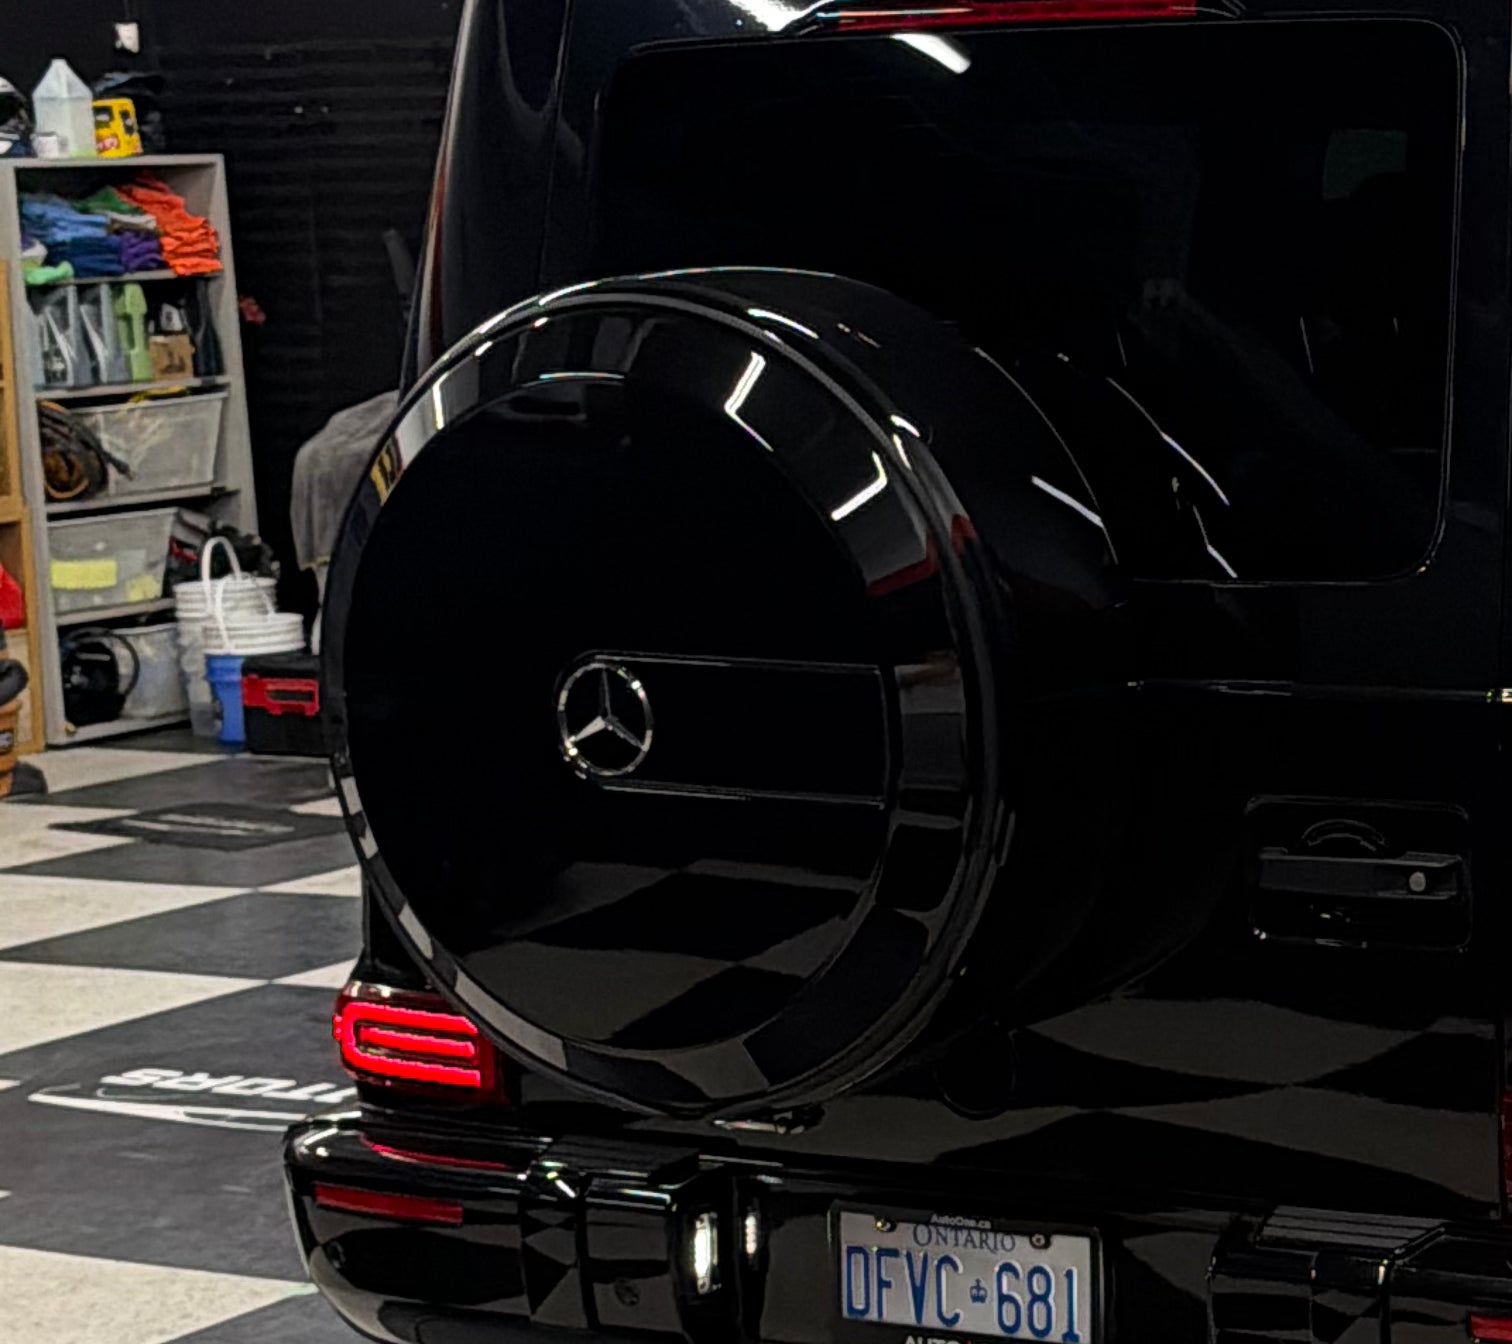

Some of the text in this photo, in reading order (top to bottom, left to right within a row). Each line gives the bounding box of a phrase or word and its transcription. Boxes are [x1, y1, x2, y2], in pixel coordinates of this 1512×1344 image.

[931, 1213, 992, 1229] AutoOne.ca
[912, 1225, 1016, 1253] ONTARIO
[846, 1244, 1081, 1344] DFVC 681
